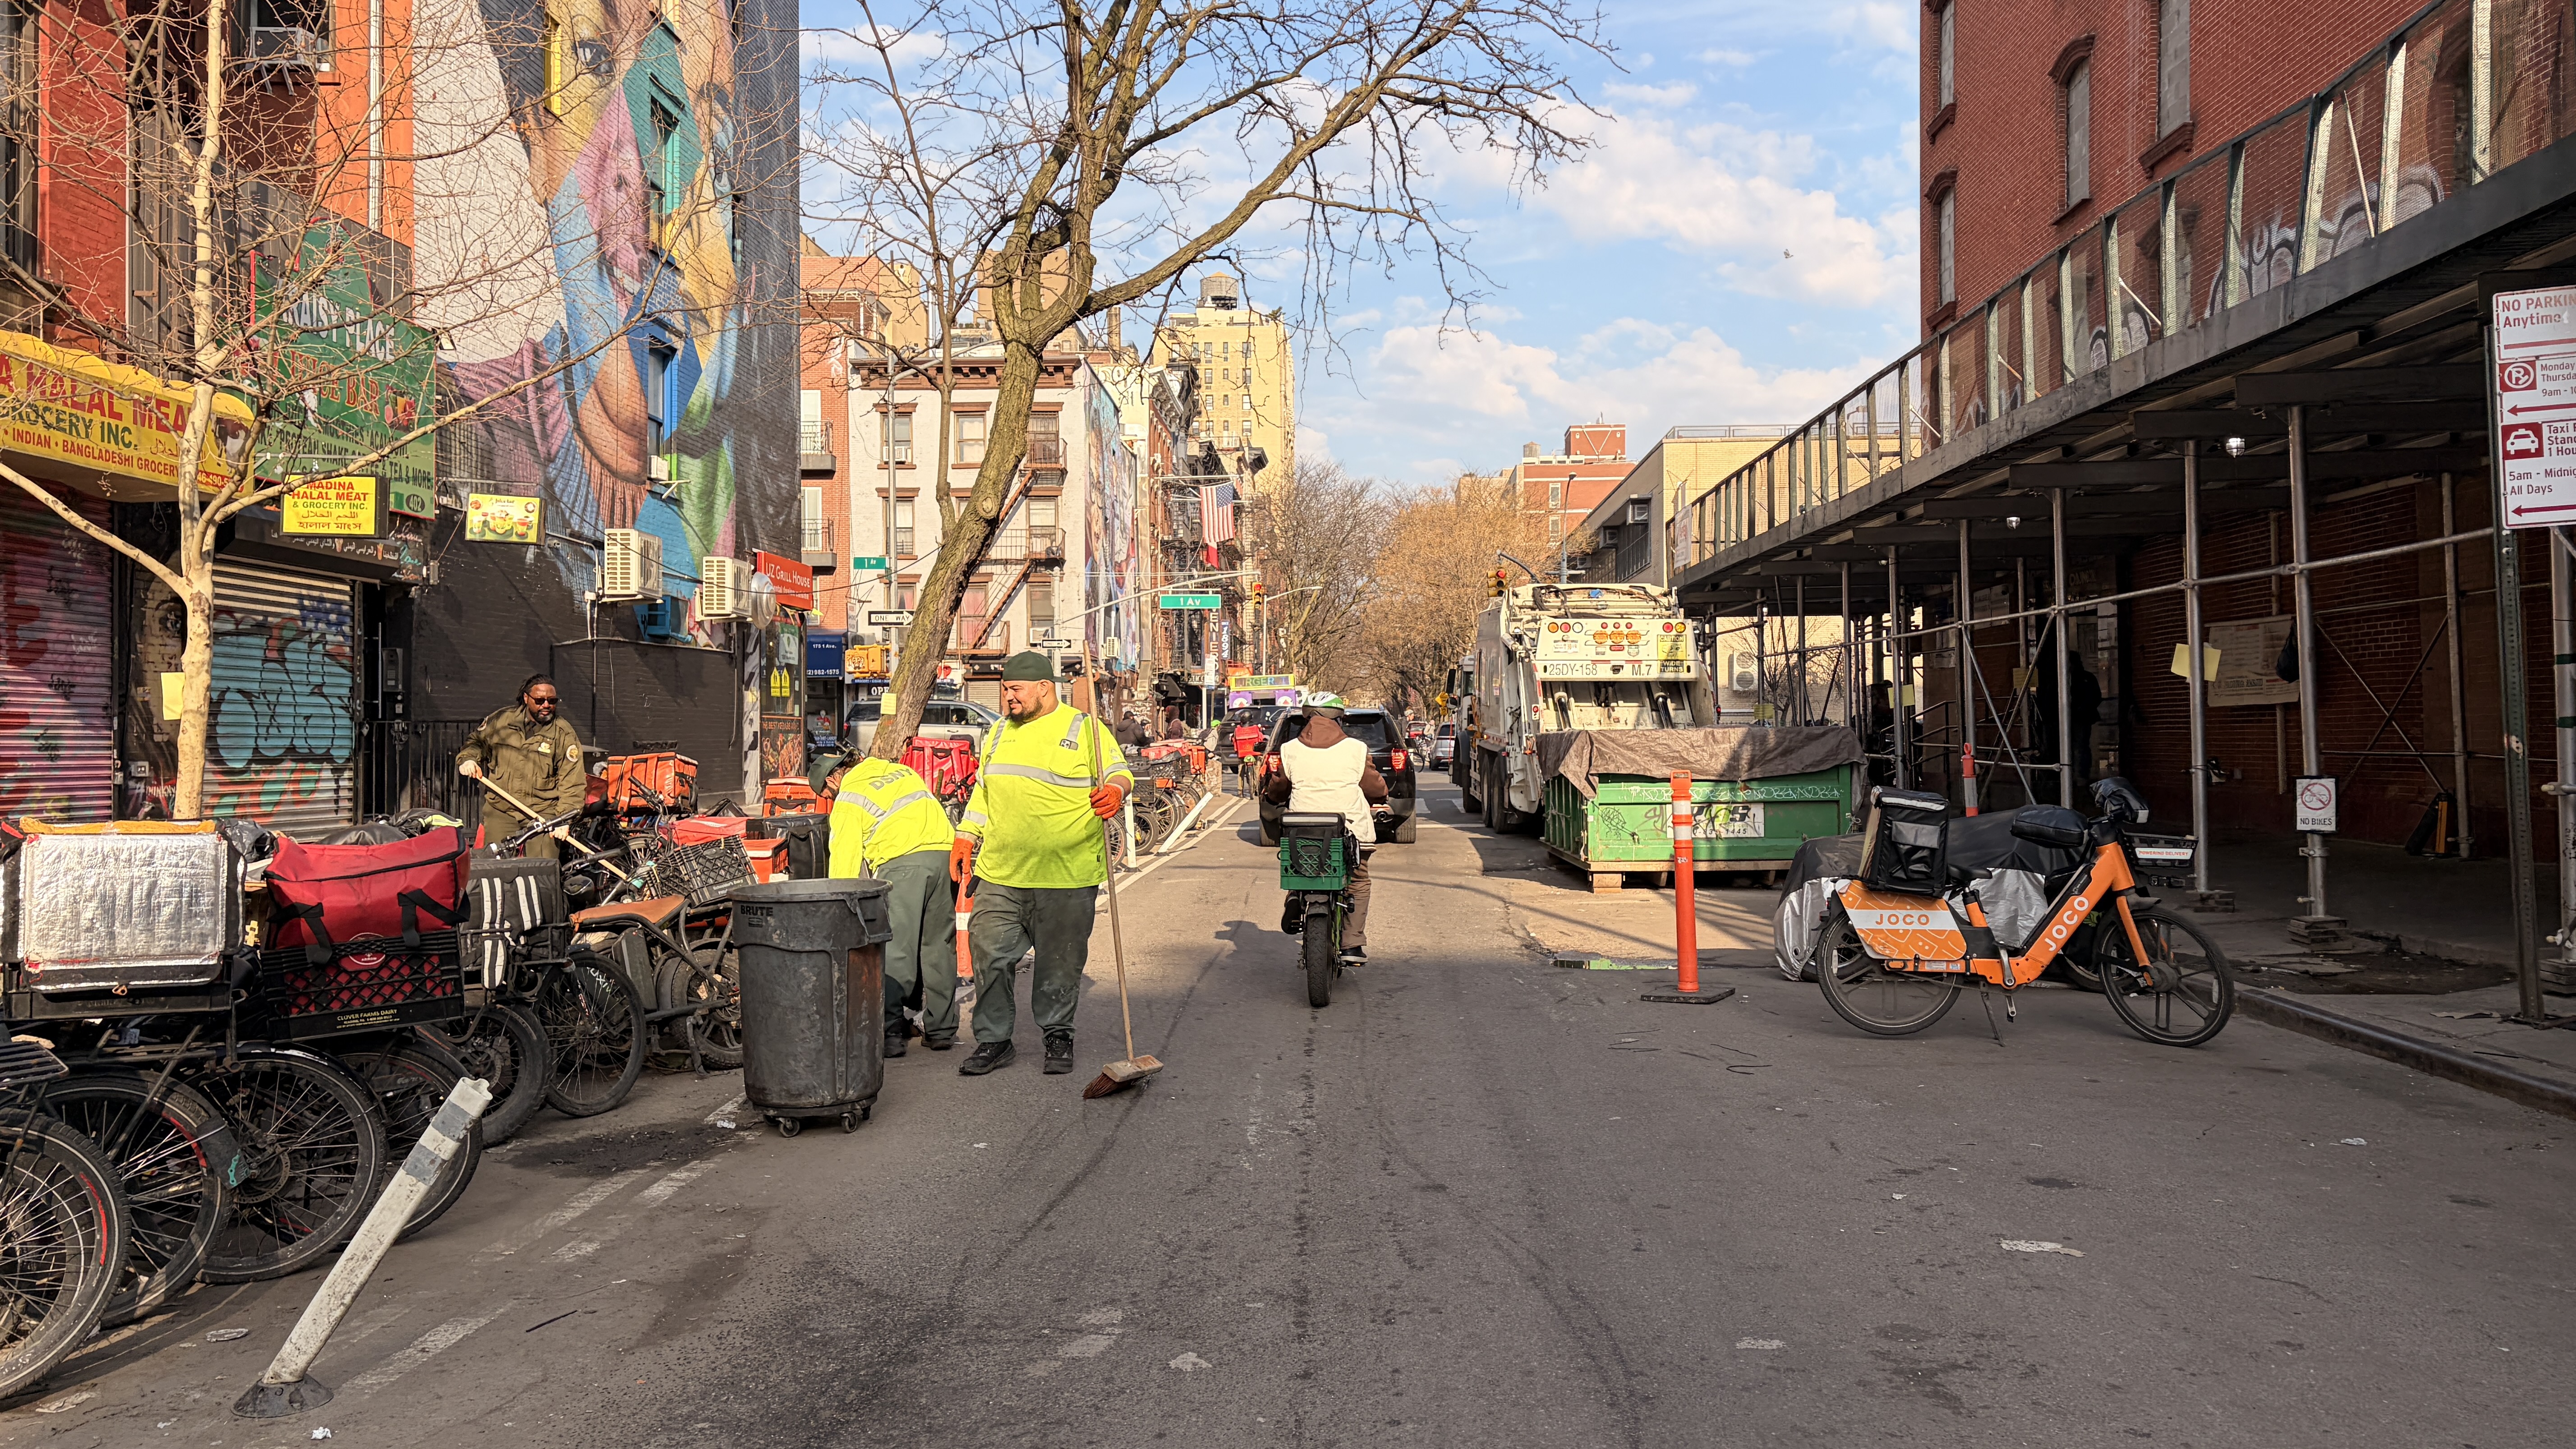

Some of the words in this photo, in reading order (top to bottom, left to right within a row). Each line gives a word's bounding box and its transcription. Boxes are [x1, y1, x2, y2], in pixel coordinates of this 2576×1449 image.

[2502, 299, 2521, 313] NO
[2503, 313, 2561, 329] Anytime
[345, 307, 395, 362] PLACE
[2540, 362, 2576, 372] Monday
[345, 375, 380, 415] BAR
[2542, 388, 2561, 397] 9am
[27, 362, 123, 422] HALAL
[133, 391, 190, 437] MEA
[2547, 423, 2569, 434] Taxi
[100, 421, 138, 451] INC.
[13, 427, 51, 449] INDIAN
[62, 439, 134, 468] BANGLADESHI
[2548, 447, 2552, 457] 1
[389, 460, 403, 483] TEA
[2509, 471, 2532, 481] 5am
[306, 481, 354, 491] MADINA
[2510, 485, 2523, 496] All
[2527, 484, 2553, 495] Days
[292, 492, 332, 500] HALAL
[336, 492, 368, 501] MEAT
[303, 501, 346, 510] GROCERY
[349, 502, 368, 511] INC.
[409, 496, 422, 511] 402
[302, 511, 332, 519] الحلال
[297, 521, 330, 529] হালাল
[335, 522, 362, 530] মাংস
[865, 558, 868, 568] 1
[766, 562, 775, 578] UZ
[776, 566, 792, 583] GRILL
[792, 570, 810, 588] HOUSE
[1180, 598, 1184, 606] 1
[1186, 598, 1201, 606] Av
[1221, 626, 1229, 658] 1894
[1549, 663, 1598, 676] 25DY-158
[868, 768, 913, 791] DSNY
[741, 905, 774, 917] BRUTE
[1875, 913, 1930, 926] JOCO
[2045, 896, 2089, 952] JOCO
